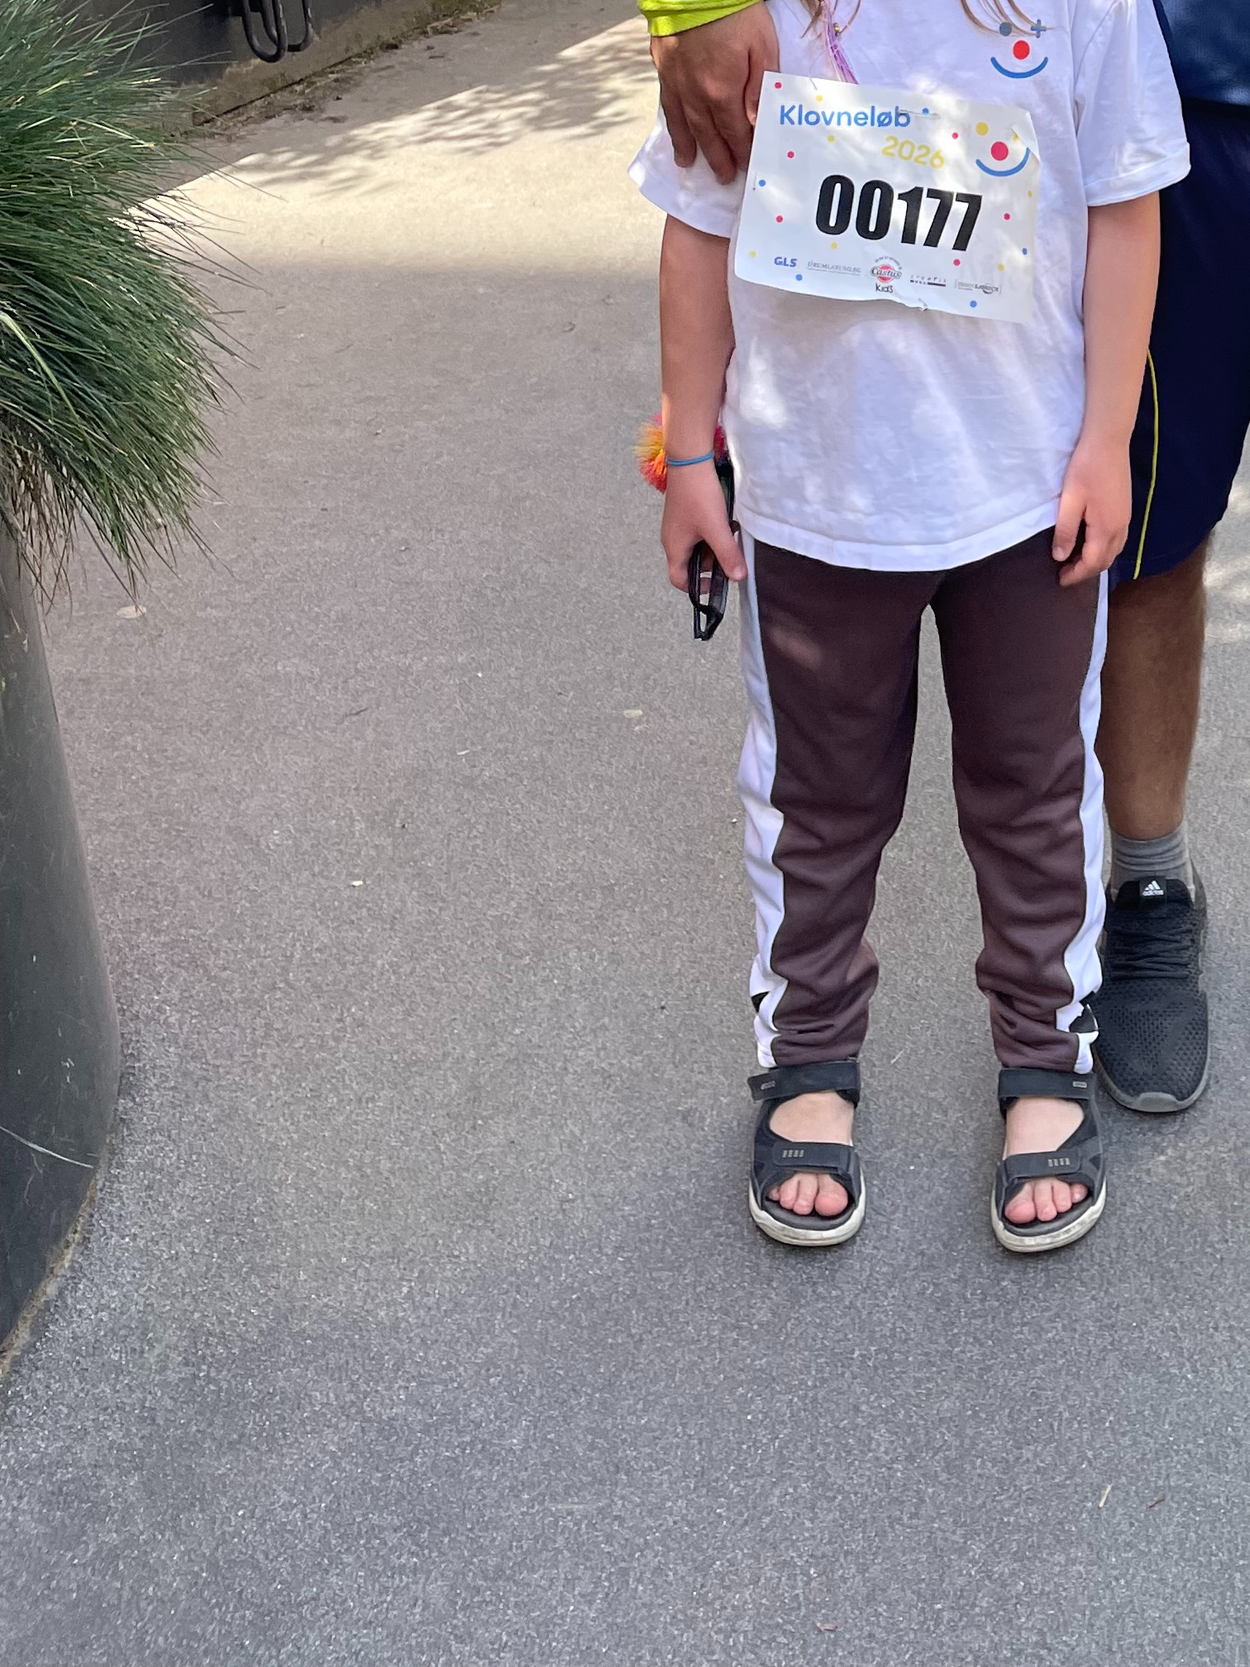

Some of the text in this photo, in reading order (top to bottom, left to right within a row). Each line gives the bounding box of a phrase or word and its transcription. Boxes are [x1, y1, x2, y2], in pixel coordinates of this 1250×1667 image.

[779, 104, 911, 128] Klovneløb
[881, 136, 945, 169] 2026
[815, 174, 983, 252] 00177
[773, 256, 797, 267] GLS
